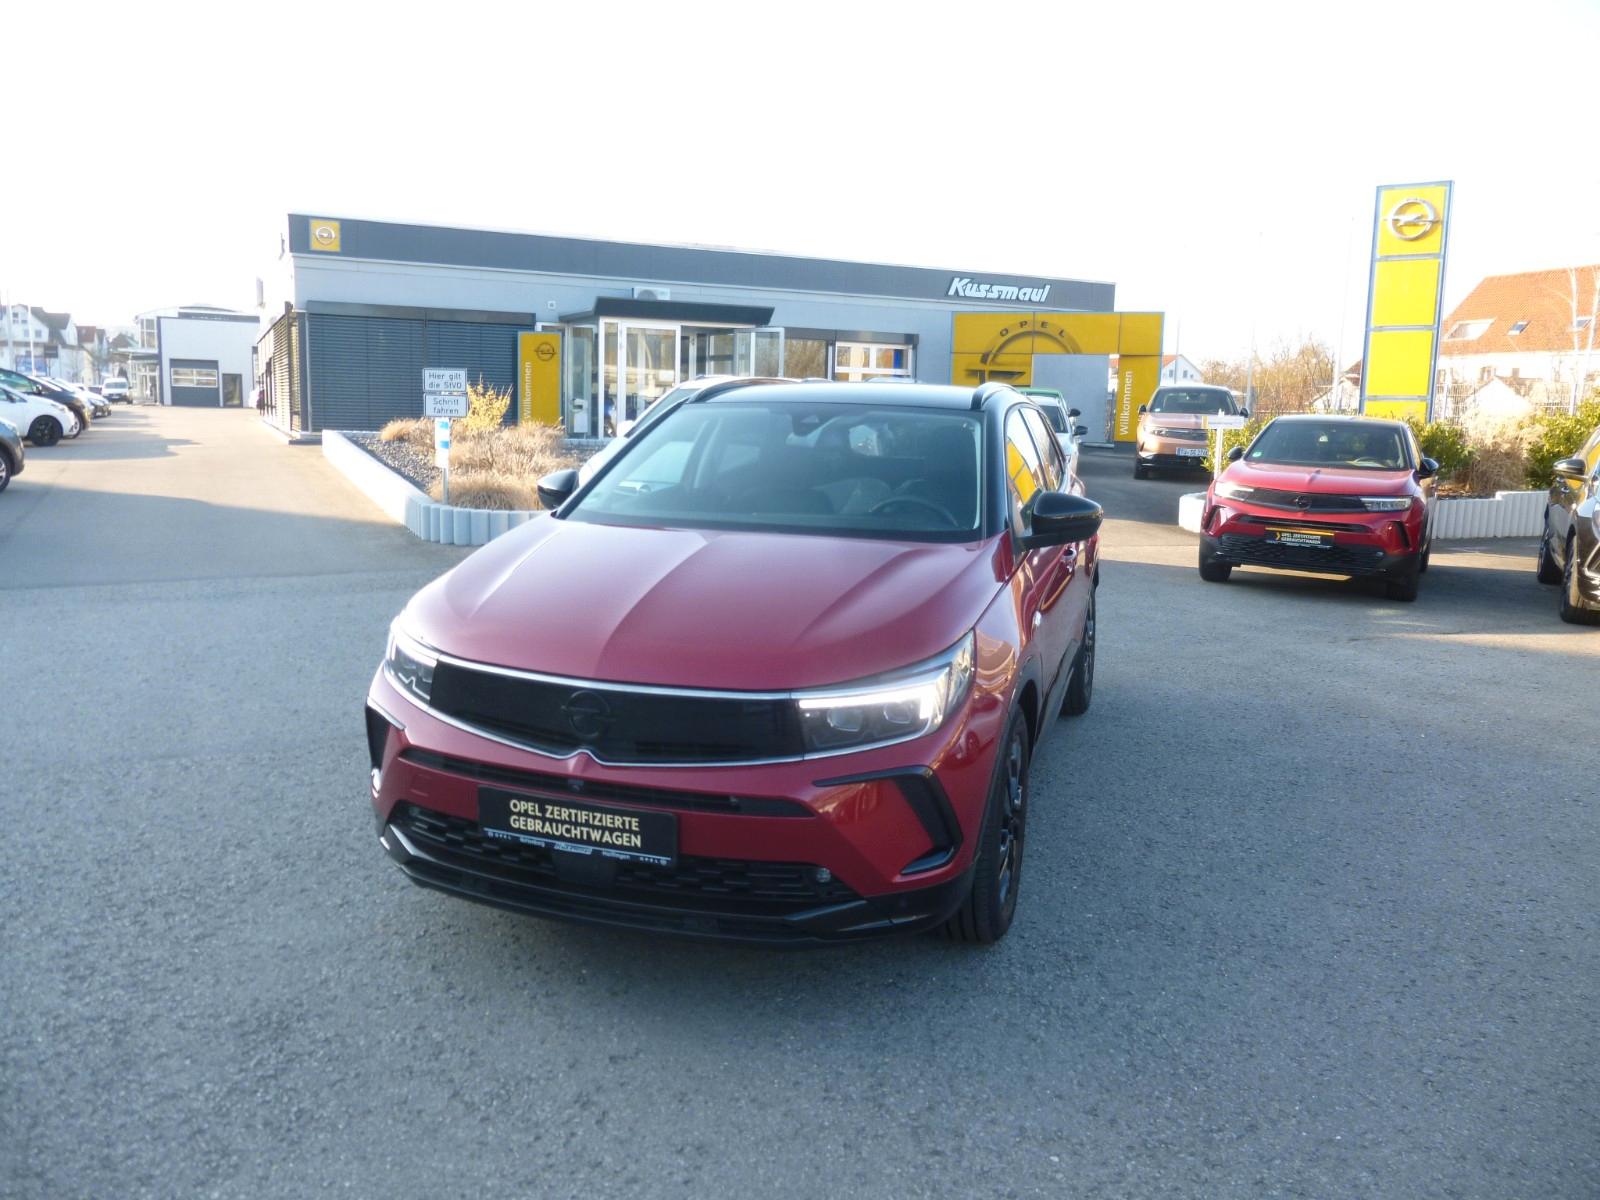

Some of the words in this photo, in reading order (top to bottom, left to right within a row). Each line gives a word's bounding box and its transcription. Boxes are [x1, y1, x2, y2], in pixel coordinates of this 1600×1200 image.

[948, 277, 1051, 303] Kussmaul
[999, 320, 1066, 338] OPEL
[428, 372, 445, 381] Hier
[448, 372, 462, 382] gilt
[428, 381, 440, 389] die
[444, 381, 462, 389] StVO
[433, 397, 459, 406] Schritt
[433, 406, 459, 415] fahren
[1119, 371, 1133, 436] Willkommen
[509, 799, 542, 817] OPEL
[544, 804, 640, 832] ZERTIFIZIERTE
[509, 815, 642, 848] GEBRAUCHTWAGEN
